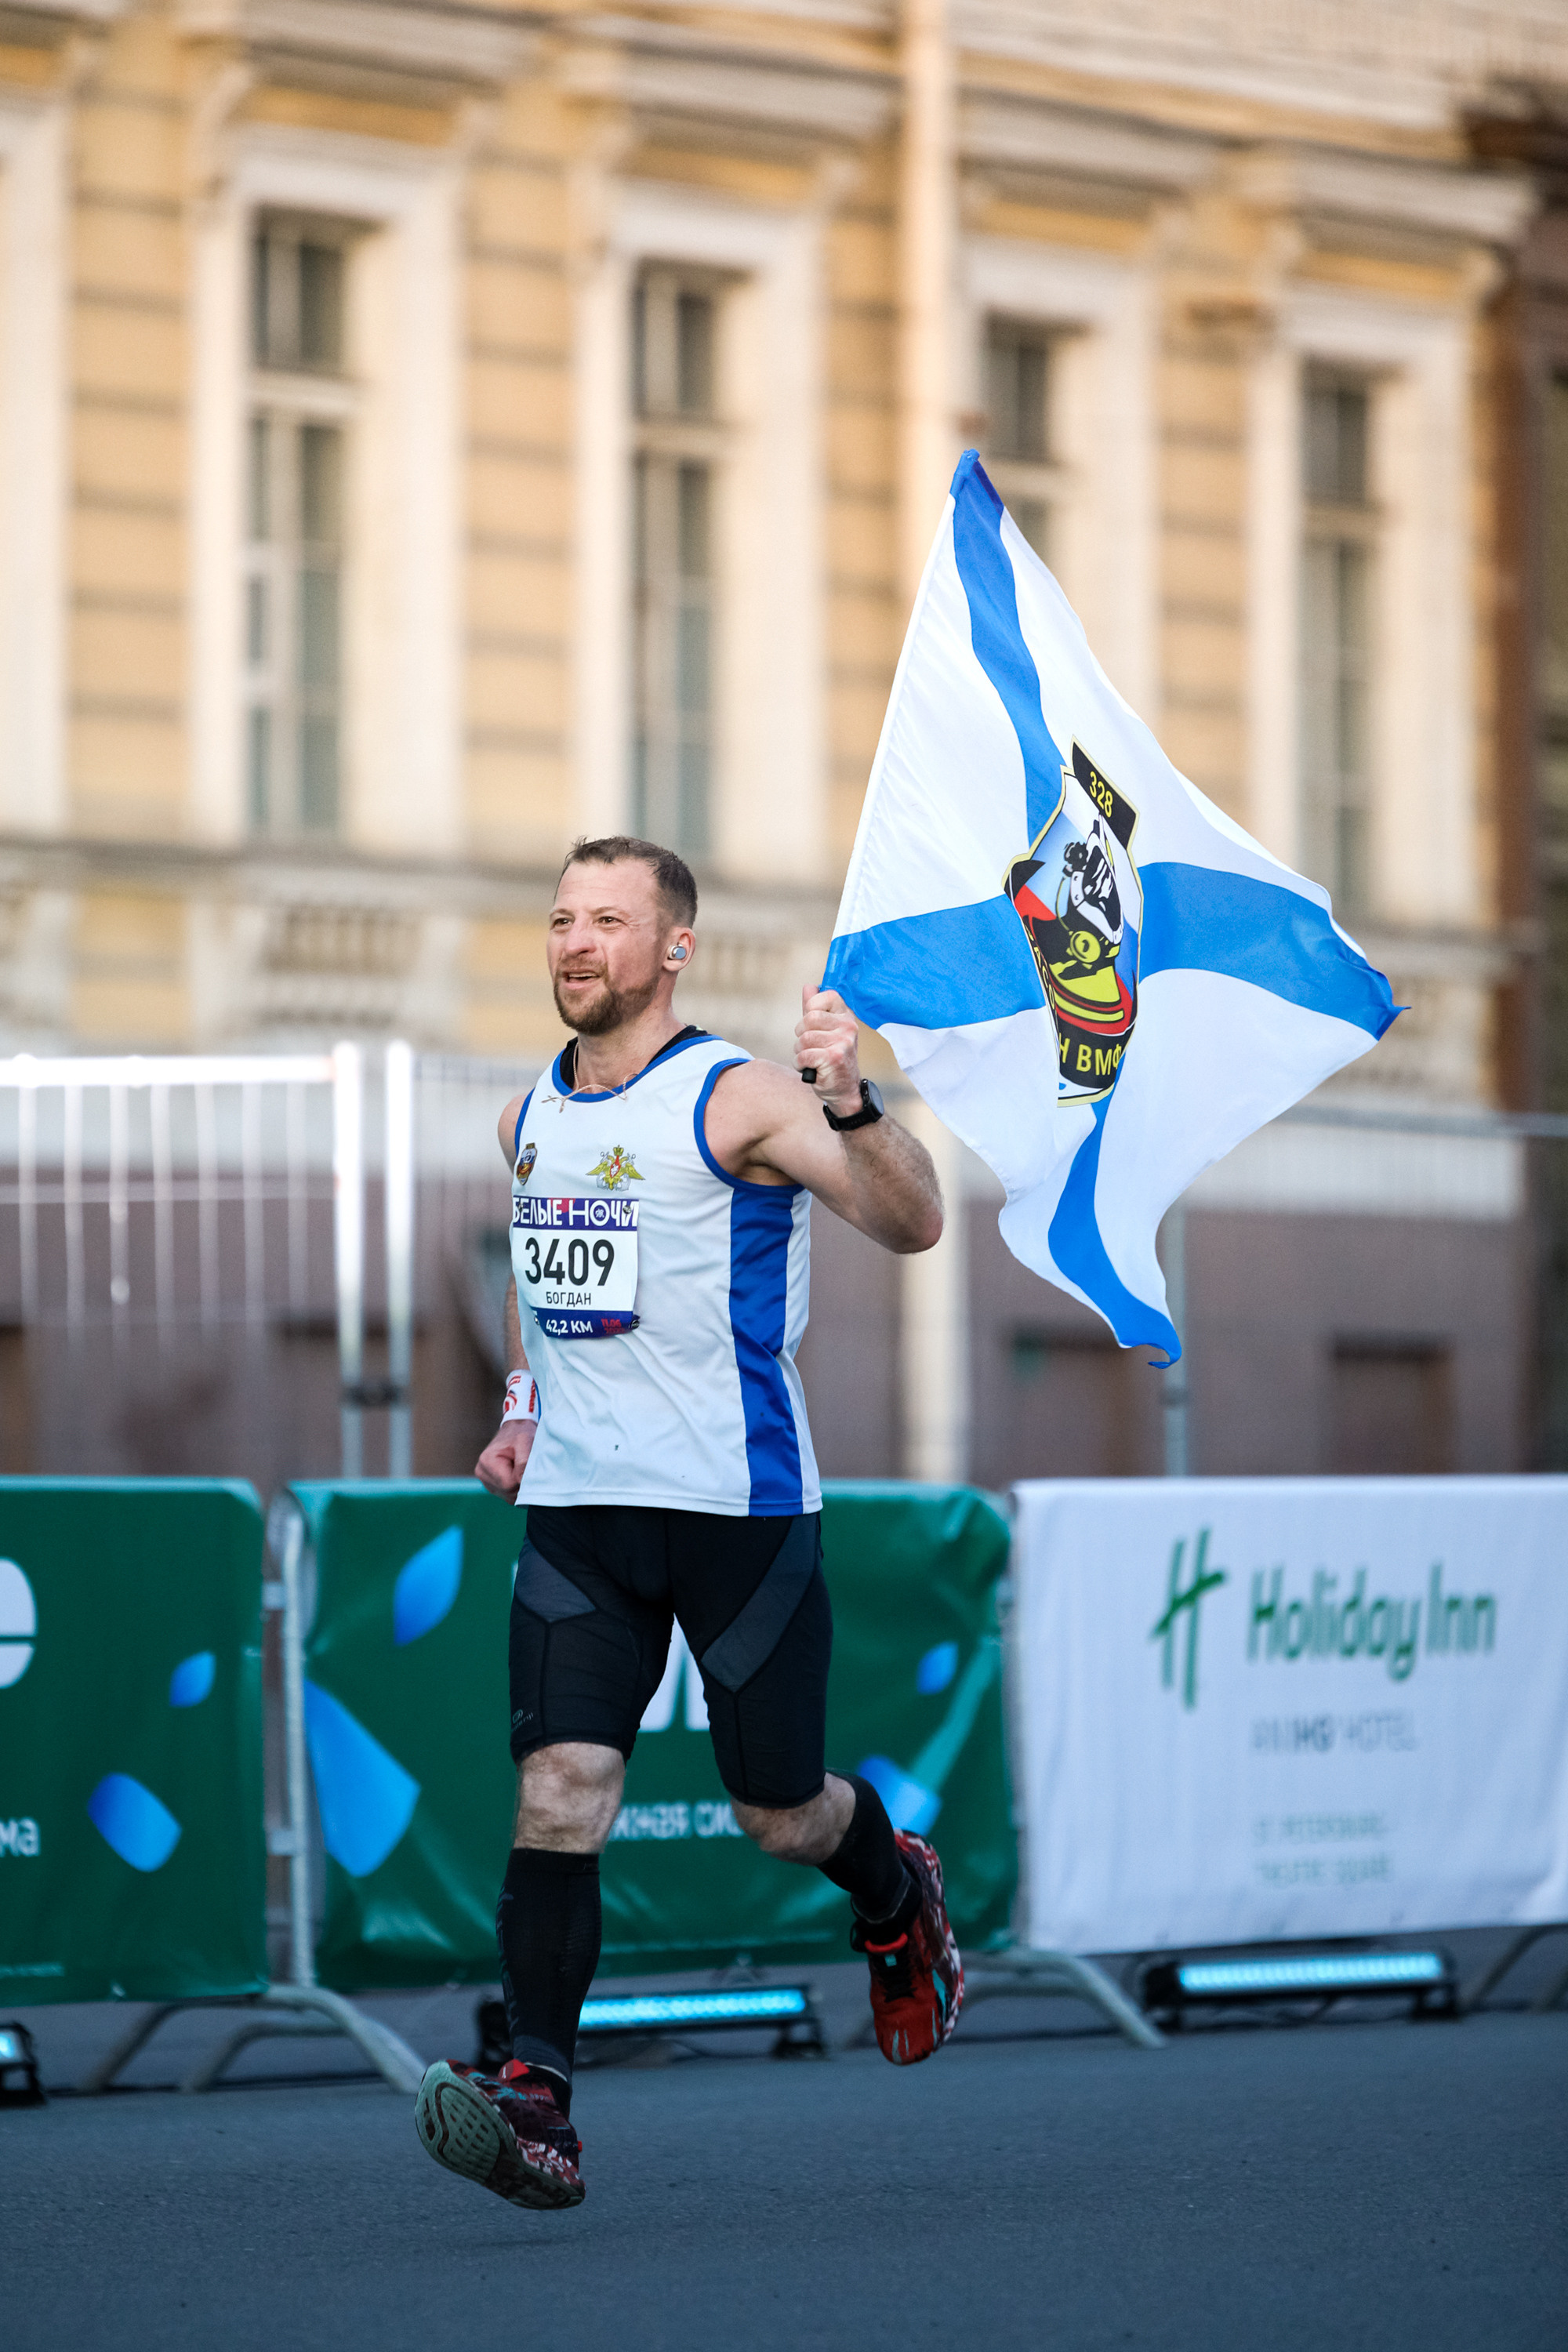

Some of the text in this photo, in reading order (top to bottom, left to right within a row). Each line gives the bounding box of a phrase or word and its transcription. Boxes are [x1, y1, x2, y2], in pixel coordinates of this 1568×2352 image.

[1089, 771, 1113, 818] 328
[1076, 1044, 1122, 1076] ВМФ
[513, 1198, 639, 1226] БЕЛЫЕ НОЧИ
[524, 1237, 615, 1286] 3409
[546, 1291, 591, 1307] БОГДАН
[546, 1319, 569, 1336] 42,2
[570, 1320, 593, 1334] КМ
[1248, 1559, 1497, 1681] Holiday Inn
